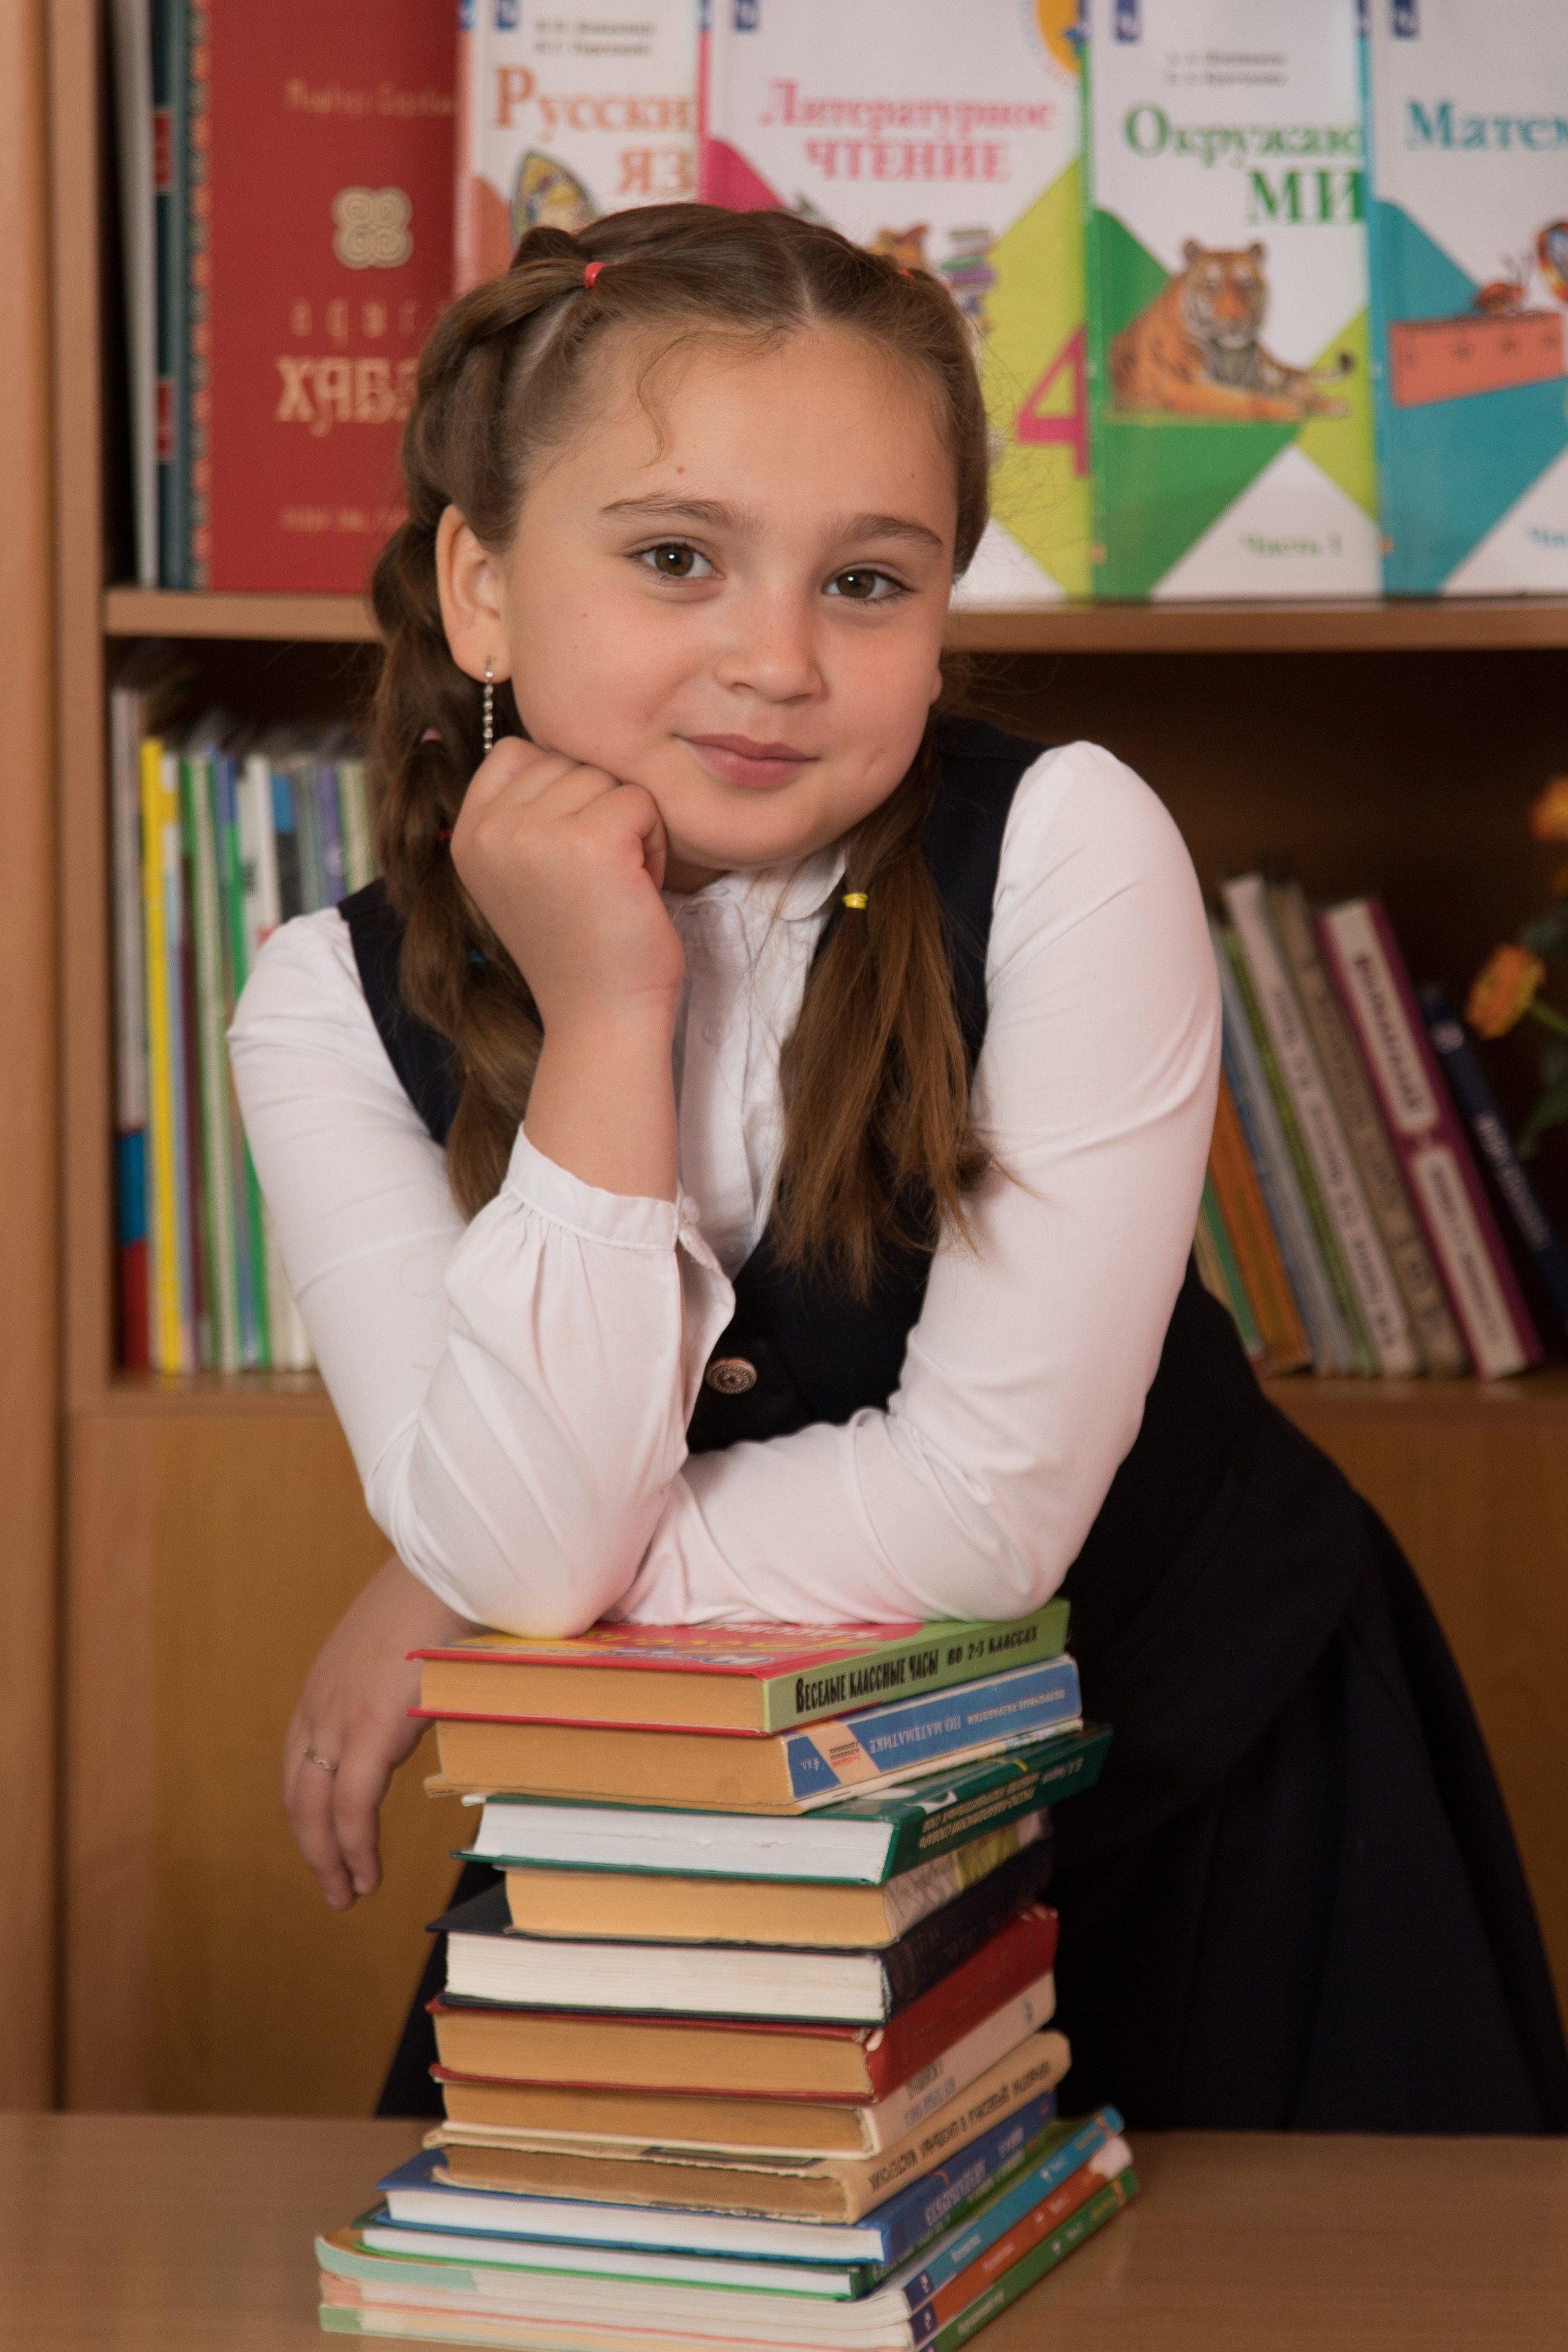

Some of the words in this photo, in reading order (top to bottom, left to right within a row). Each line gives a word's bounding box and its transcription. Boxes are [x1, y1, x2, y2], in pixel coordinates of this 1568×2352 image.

[760, 78, 1056, 137] Литературное
[804, 138, 1012, 183] ЧТЕНИЕ
[1016, 323, 1094, 478] 4
[849, 1657, 906, 1699] КЛАССНЫЕ
[908, 1649, 939, 1681] ЧАСЫ
[948, 1646, 963, 1667] ВО
[988, 1626, 1039, 1654] КЛАССАХ
[869, 1720, 943, 1755] МАТЕМАТИКЕ
[943, 1716, 962, 1732] ПО
[813, 1757, 821, 1772] 4
